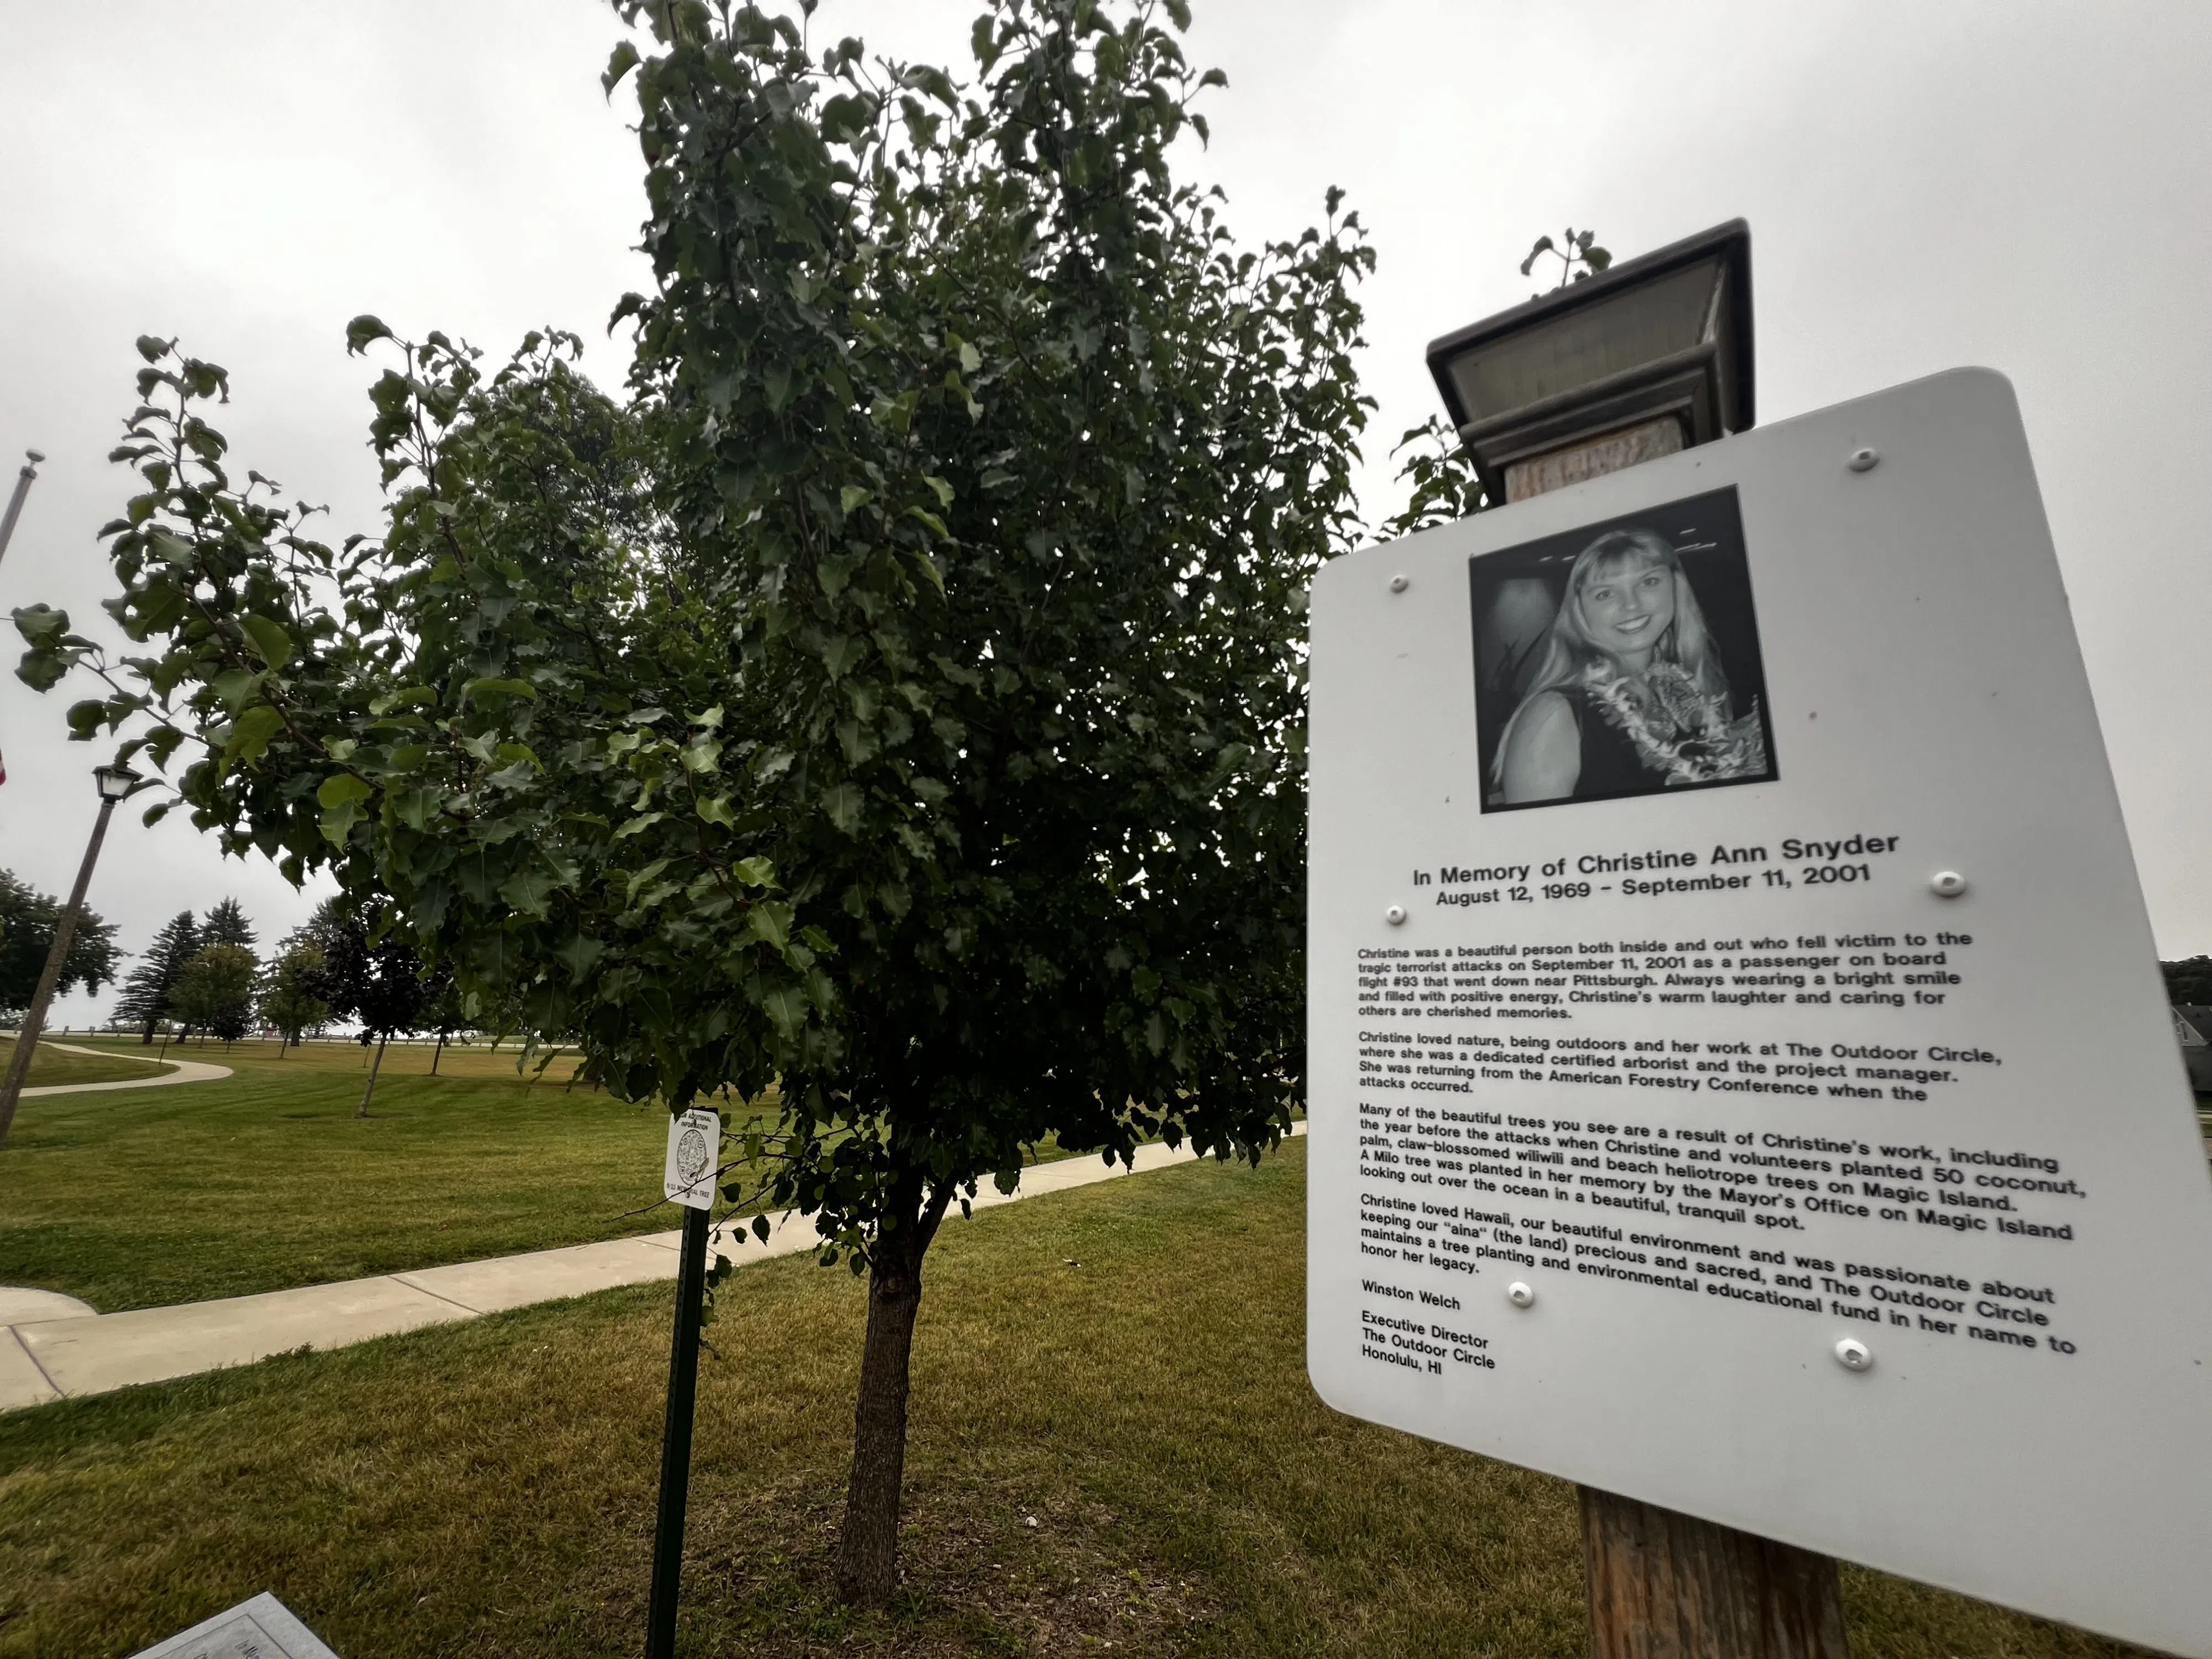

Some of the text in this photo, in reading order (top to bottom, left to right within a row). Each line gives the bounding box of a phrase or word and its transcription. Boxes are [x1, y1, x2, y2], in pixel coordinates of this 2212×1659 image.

[1413, 833, 1900, 886] In Memory of Christine Ann Snyder
[1436, 863, 1871, 907] August 12, 1969 September 11, 2001
[1358, 932, 1973, 959] Christine was a beautiful person both inside and out who fell victim to the
[1358, 951, 1947, 975] tragic terrorist attacks on September 11, 2001 as a passenger on board
[1359, 1031, 2001, 1066] Christine loved nature, being outdoors and her work at The Outdoor Circle,
[1359, 1060, 1928, 1102] She was returning from the American Forestry Conference when the
[1359, 1103, 1392, 1118] Many
[1396, 1106, 1410, 1117] of
[1415, 1107, 1437, 1120] the
[1441, 1109, 1502, 1125] beautiful
[1507, 1114, 1546, 1129] trees
[1552, 1120, 1580, 1133] you
[1587, 1123, 1619, 1135] see
[1623, 1126, 1651, 1138] are
[1657, 1128, 1668, 1139] a
[1675, 1129, 1728, 1144] result
[1734, 1132, 1754, 1146] of
[1879, 1145, 1941, 1164] work,
[1949, 1147, 2059, 1175] including
[1360, 1118, 2086, 1198] the year before the attacks when Christine and volunteers planted 50 coconut,
[1360, 1149, 1369, 1160] A
[1374, 1150, 1400, 1164] Milo
[1404, 1154, 1431, 1168] tree
[1436, 1160, 1463, 1171] was
[1469, 1161, 1522, 1178] planted
[1528, 1166, 1542, 1180] in
[1547, 1169, 1574, 1183] her
[1579, 1175, 1647, 1194] memory
[1653, 1180, 1675, 1197] by
[1682, 1184, 1712, 1199] the
[1803, 1196, 1870, 1218] Office
[1878, 1208, 1908, 1222] on
[1915, 1208, 1987, 1233] Magic
[1996, 1217, 2075, 1241] Island
[1360, 1164, 1805, 1230] looking out over the ocean in a beautiful, tranquil spot.
[1360, 1193, 2056, 1305] Christine loved Hawaii, our beautiful environment and was passionate about
[1361, 1241, 1479, 1274] honor her legacy.
[1361, 1228, 2078, 1355] maintains a tree planting and environmental educational fund in her name to
[1361, 1279, 1460, 1310] Winston Welch
[1362, 1310, 1489, 1349] Executive Director
[1362, 1327, 1495, 1369] The Outdoor Circle
[1362, 1344, 1442, 1375] Honolulu, HI
